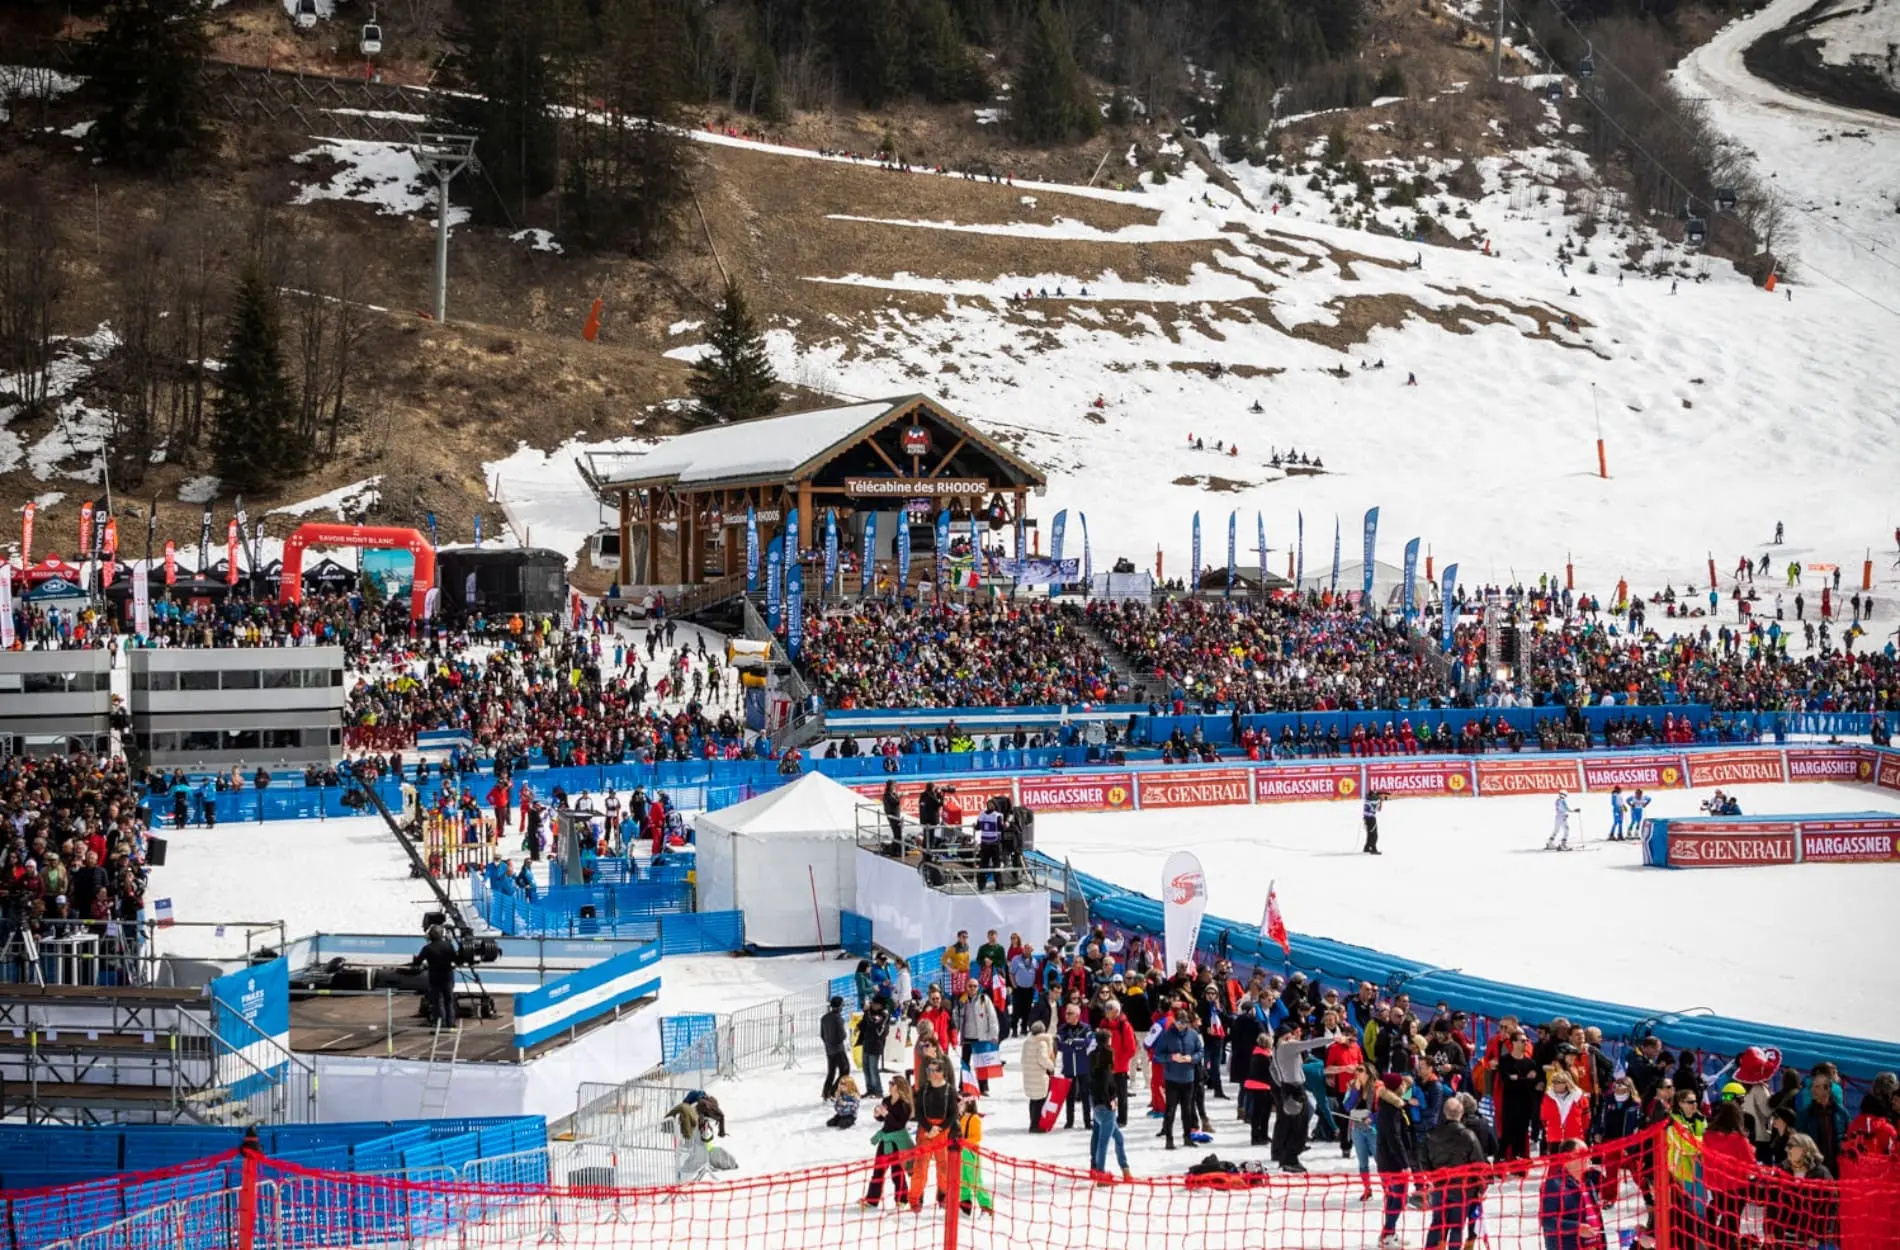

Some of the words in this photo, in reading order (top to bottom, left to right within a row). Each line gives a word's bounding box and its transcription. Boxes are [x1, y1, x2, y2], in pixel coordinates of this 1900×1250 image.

[848, 481, 908, 493] Télécabine
[914, 481, 934, 493] des
[937, 482, 986, 493] RHODOS
[1713, 763, 1781, 780] GENERALI
[1790, 760, 1857, 774] HARGASSNER
[1370, 775, 1444, 790] HARGASSNER
[1504, 772, 1578, 790] GENERALI
[1588, 769, 1658, 784] HARGASSNER
[1167, 783, 1249, 802] GENERALI
[1259, 779, 1334, 794] HARGASSNER
[1023, 788, 1103, 804] HARGASSNER
[1701, 839, 1792, 860] GENERALI
[1805, 836, 1892, 855] HARGASSNER
